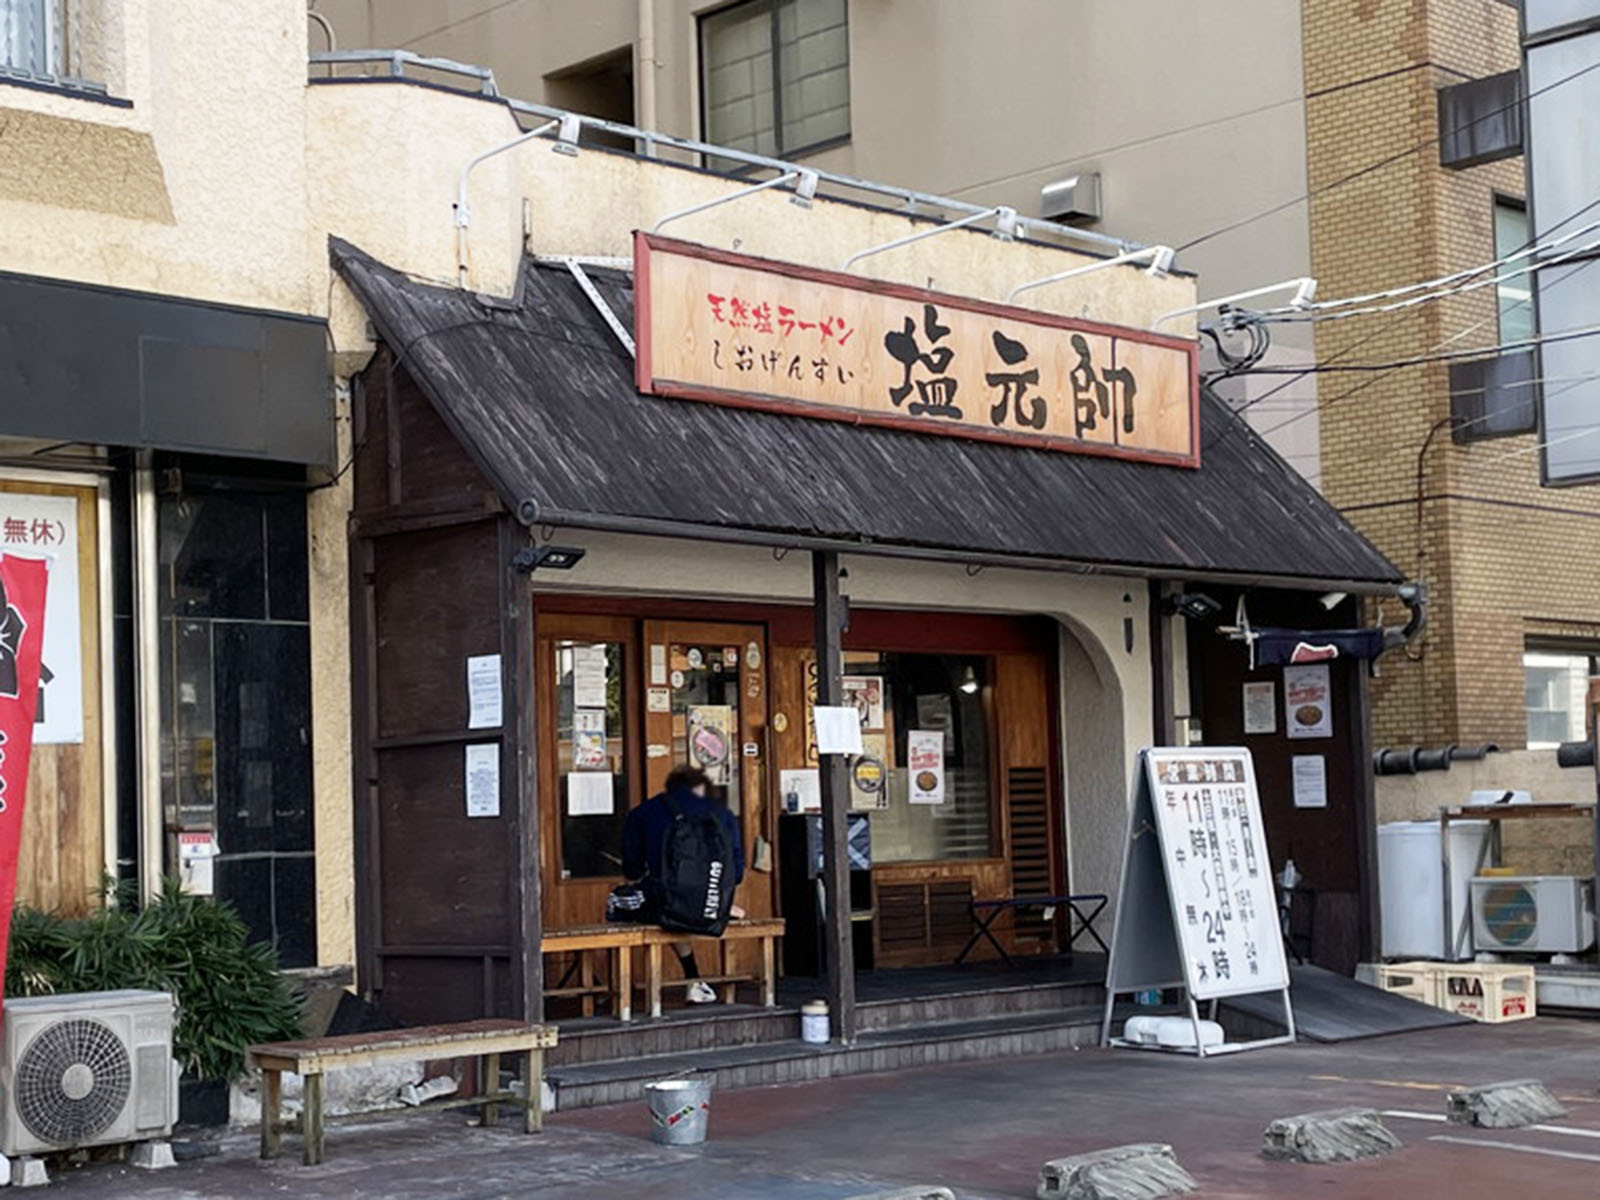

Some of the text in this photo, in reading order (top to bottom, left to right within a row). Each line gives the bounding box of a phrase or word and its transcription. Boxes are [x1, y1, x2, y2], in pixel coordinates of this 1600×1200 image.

[707, 293, 854, 346] 天然塩ラーメン
[713, 339, 854, 384] しおげんすい
[884, 304, 1137, 438] 塩元帥
